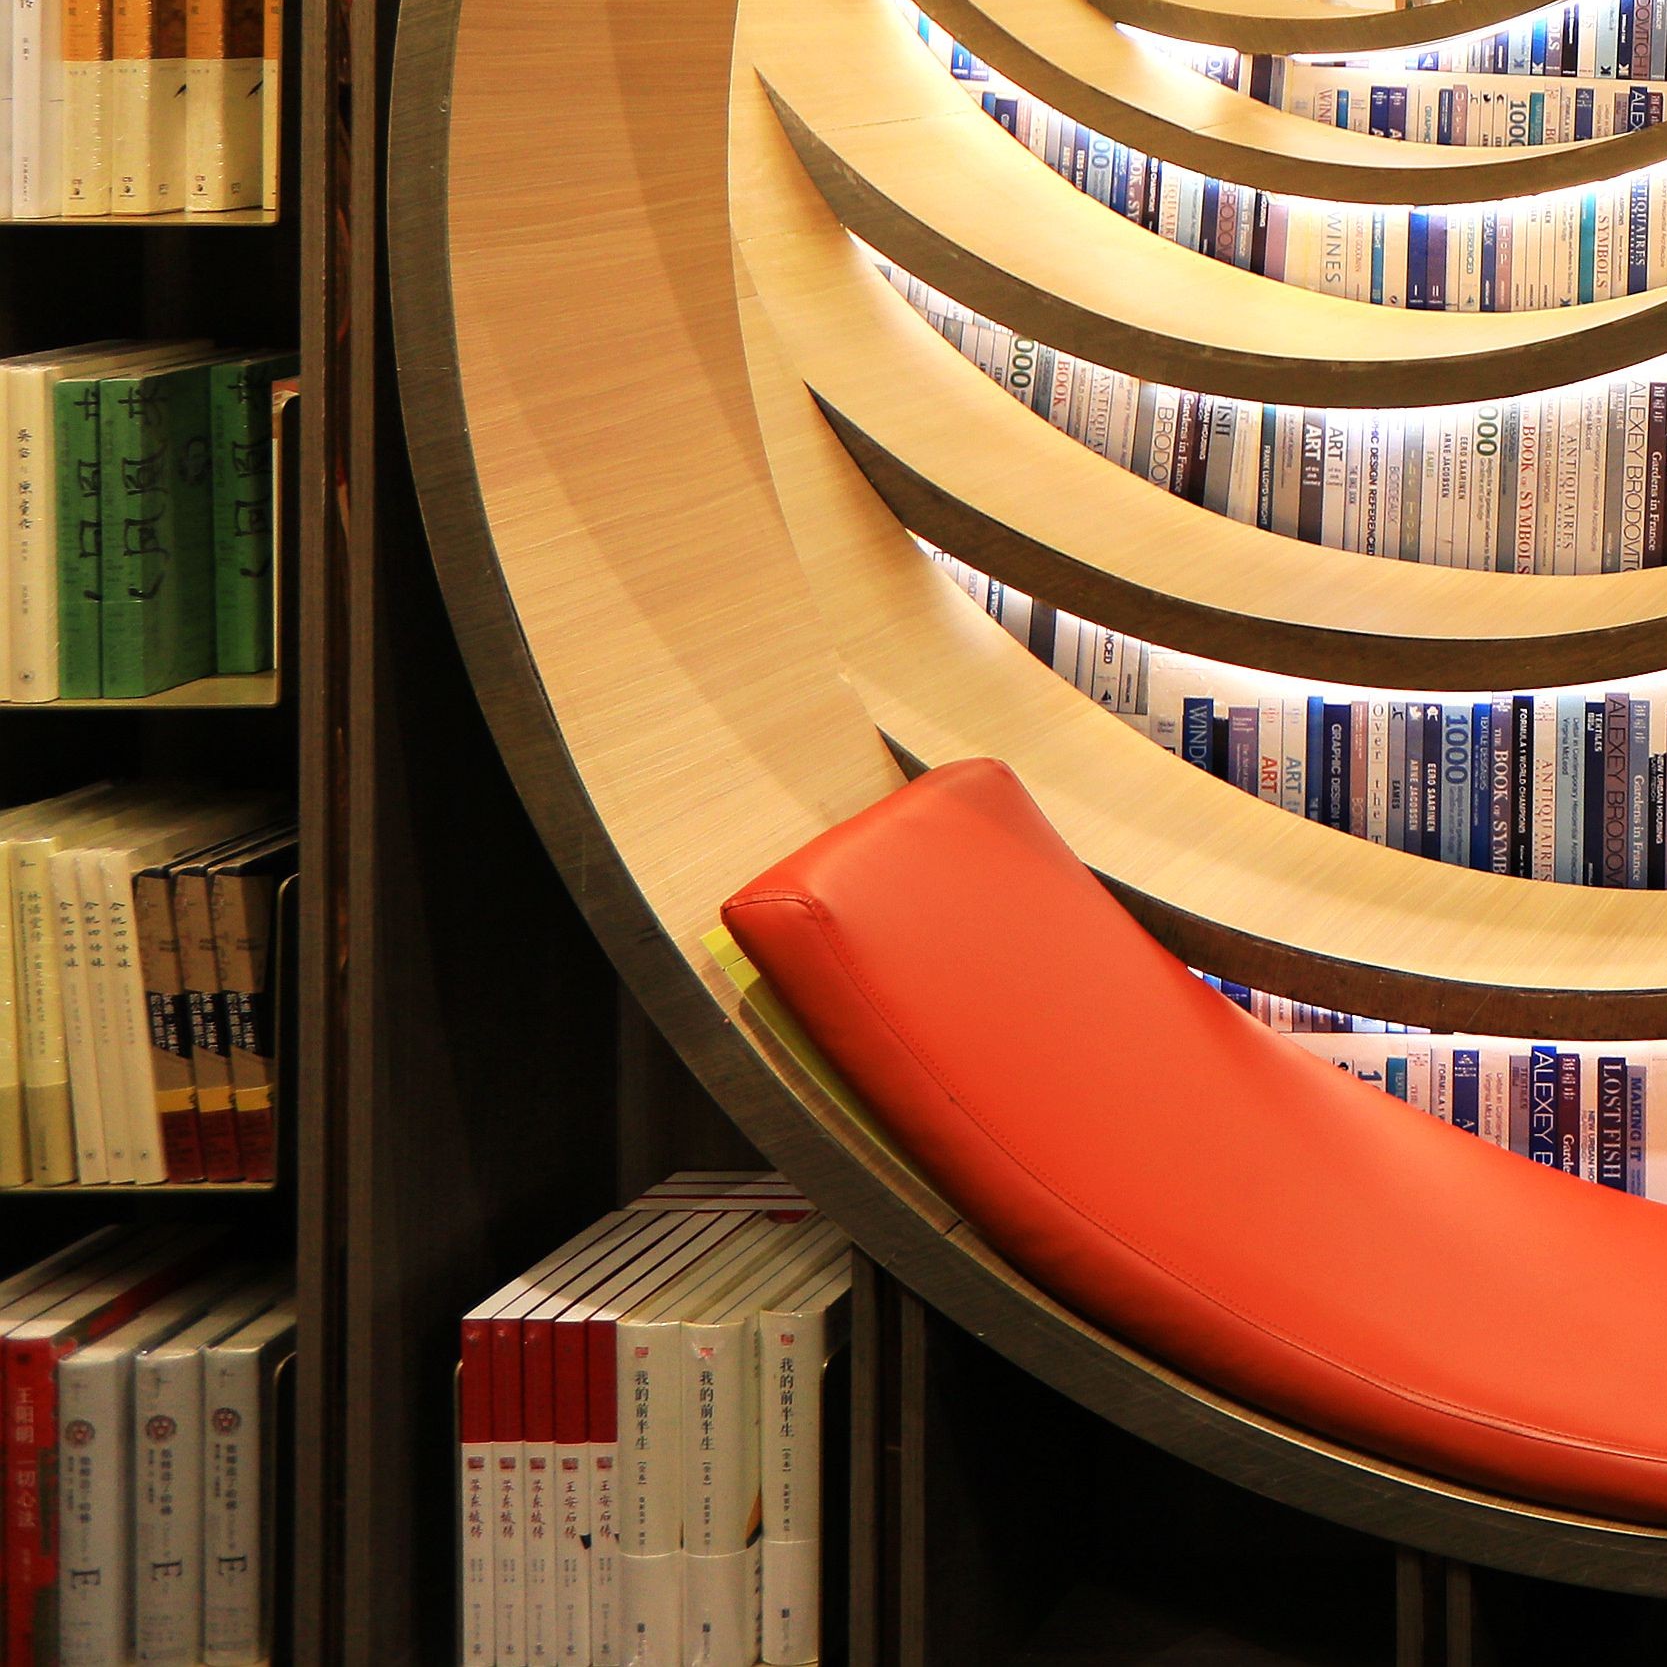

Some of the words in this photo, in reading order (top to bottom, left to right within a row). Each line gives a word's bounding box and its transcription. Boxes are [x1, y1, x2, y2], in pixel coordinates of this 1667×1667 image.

[635, 1371, 649, 1450] 我的前半生
[700, 1371, 715, 1450] 我的前半生
